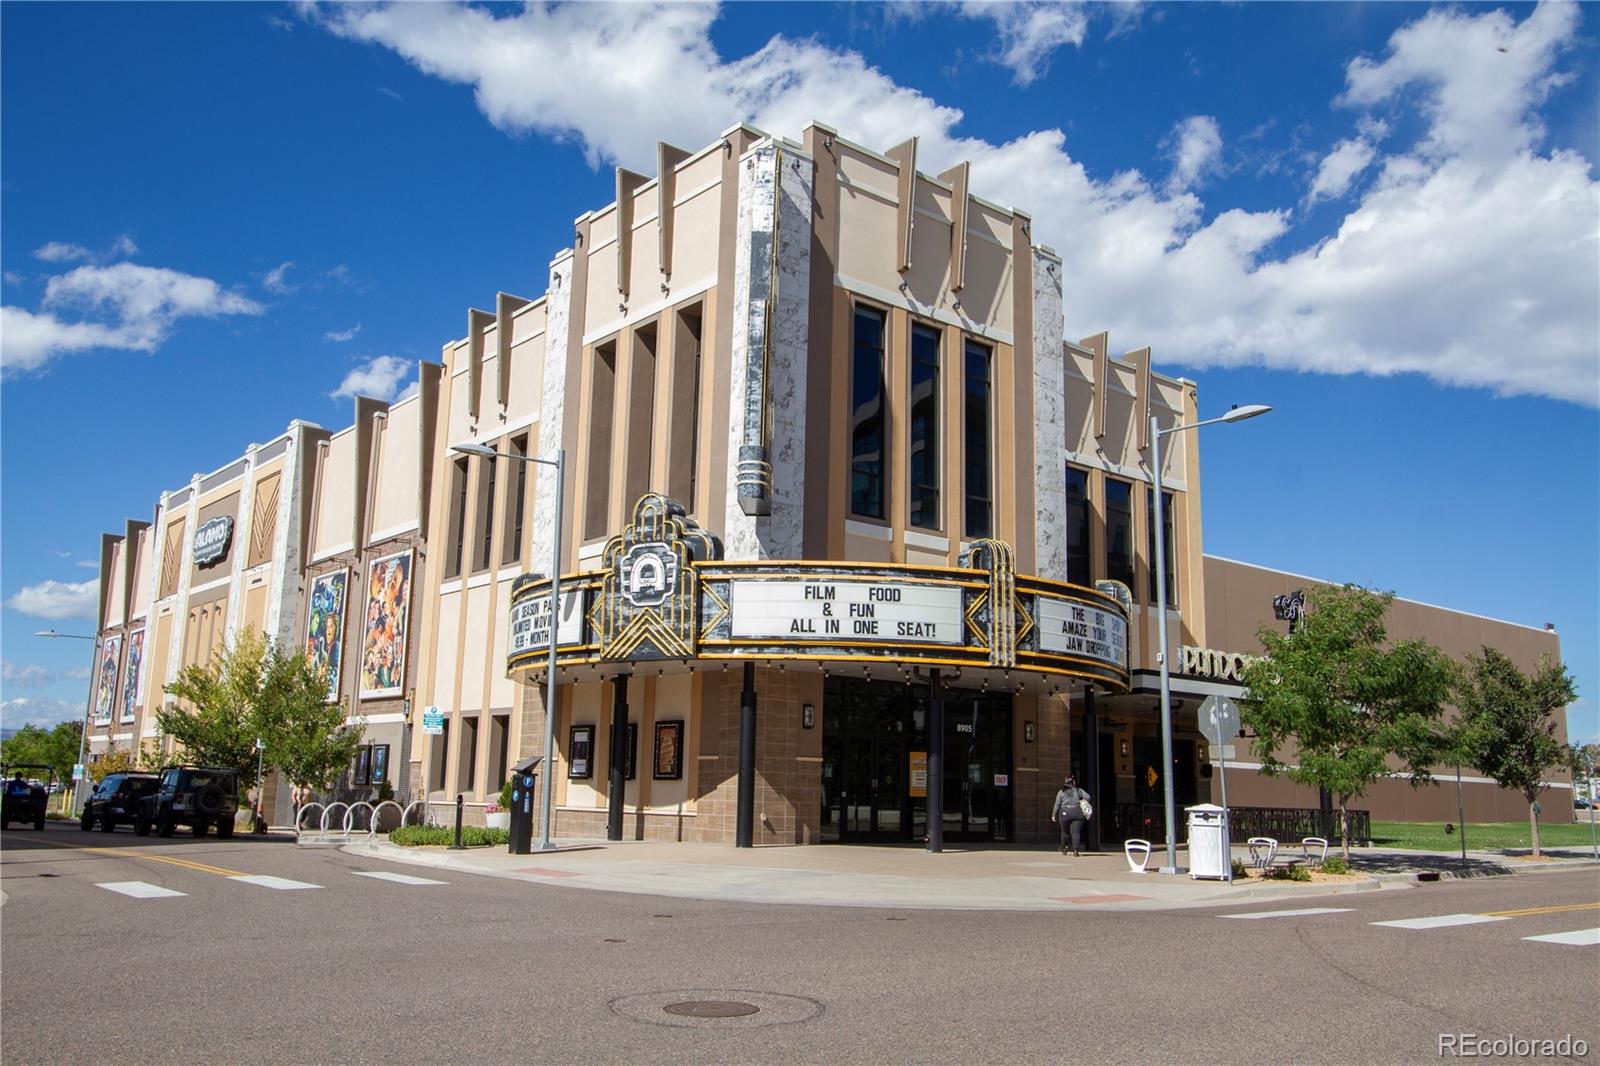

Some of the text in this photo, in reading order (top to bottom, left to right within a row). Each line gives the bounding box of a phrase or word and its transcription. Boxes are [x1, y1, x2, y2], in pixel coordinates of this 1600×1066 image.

[196, 523, 225, 549] ALAMO
[804, 585, 901, 602] FILM FOOD
[543, 598, 562, 614] PAS
[822, 602, 875, 618] & FUN
[1071, 607, 1084, 621] THE
[1095, 612, 1104, 626] BIG
[790, 619, 936, 637] ALL IN ONE SEAT!
[1062, 621, 1087, 637] AMAZE
[1092, 627, 1106, 640] YOUR
[530, 629, 550, 645] MONTH
[1066, 636, 1083, 652] JAW
[1085, 641, 1111, 657] DROPPING
[956, 723, 973, 733] 8905
